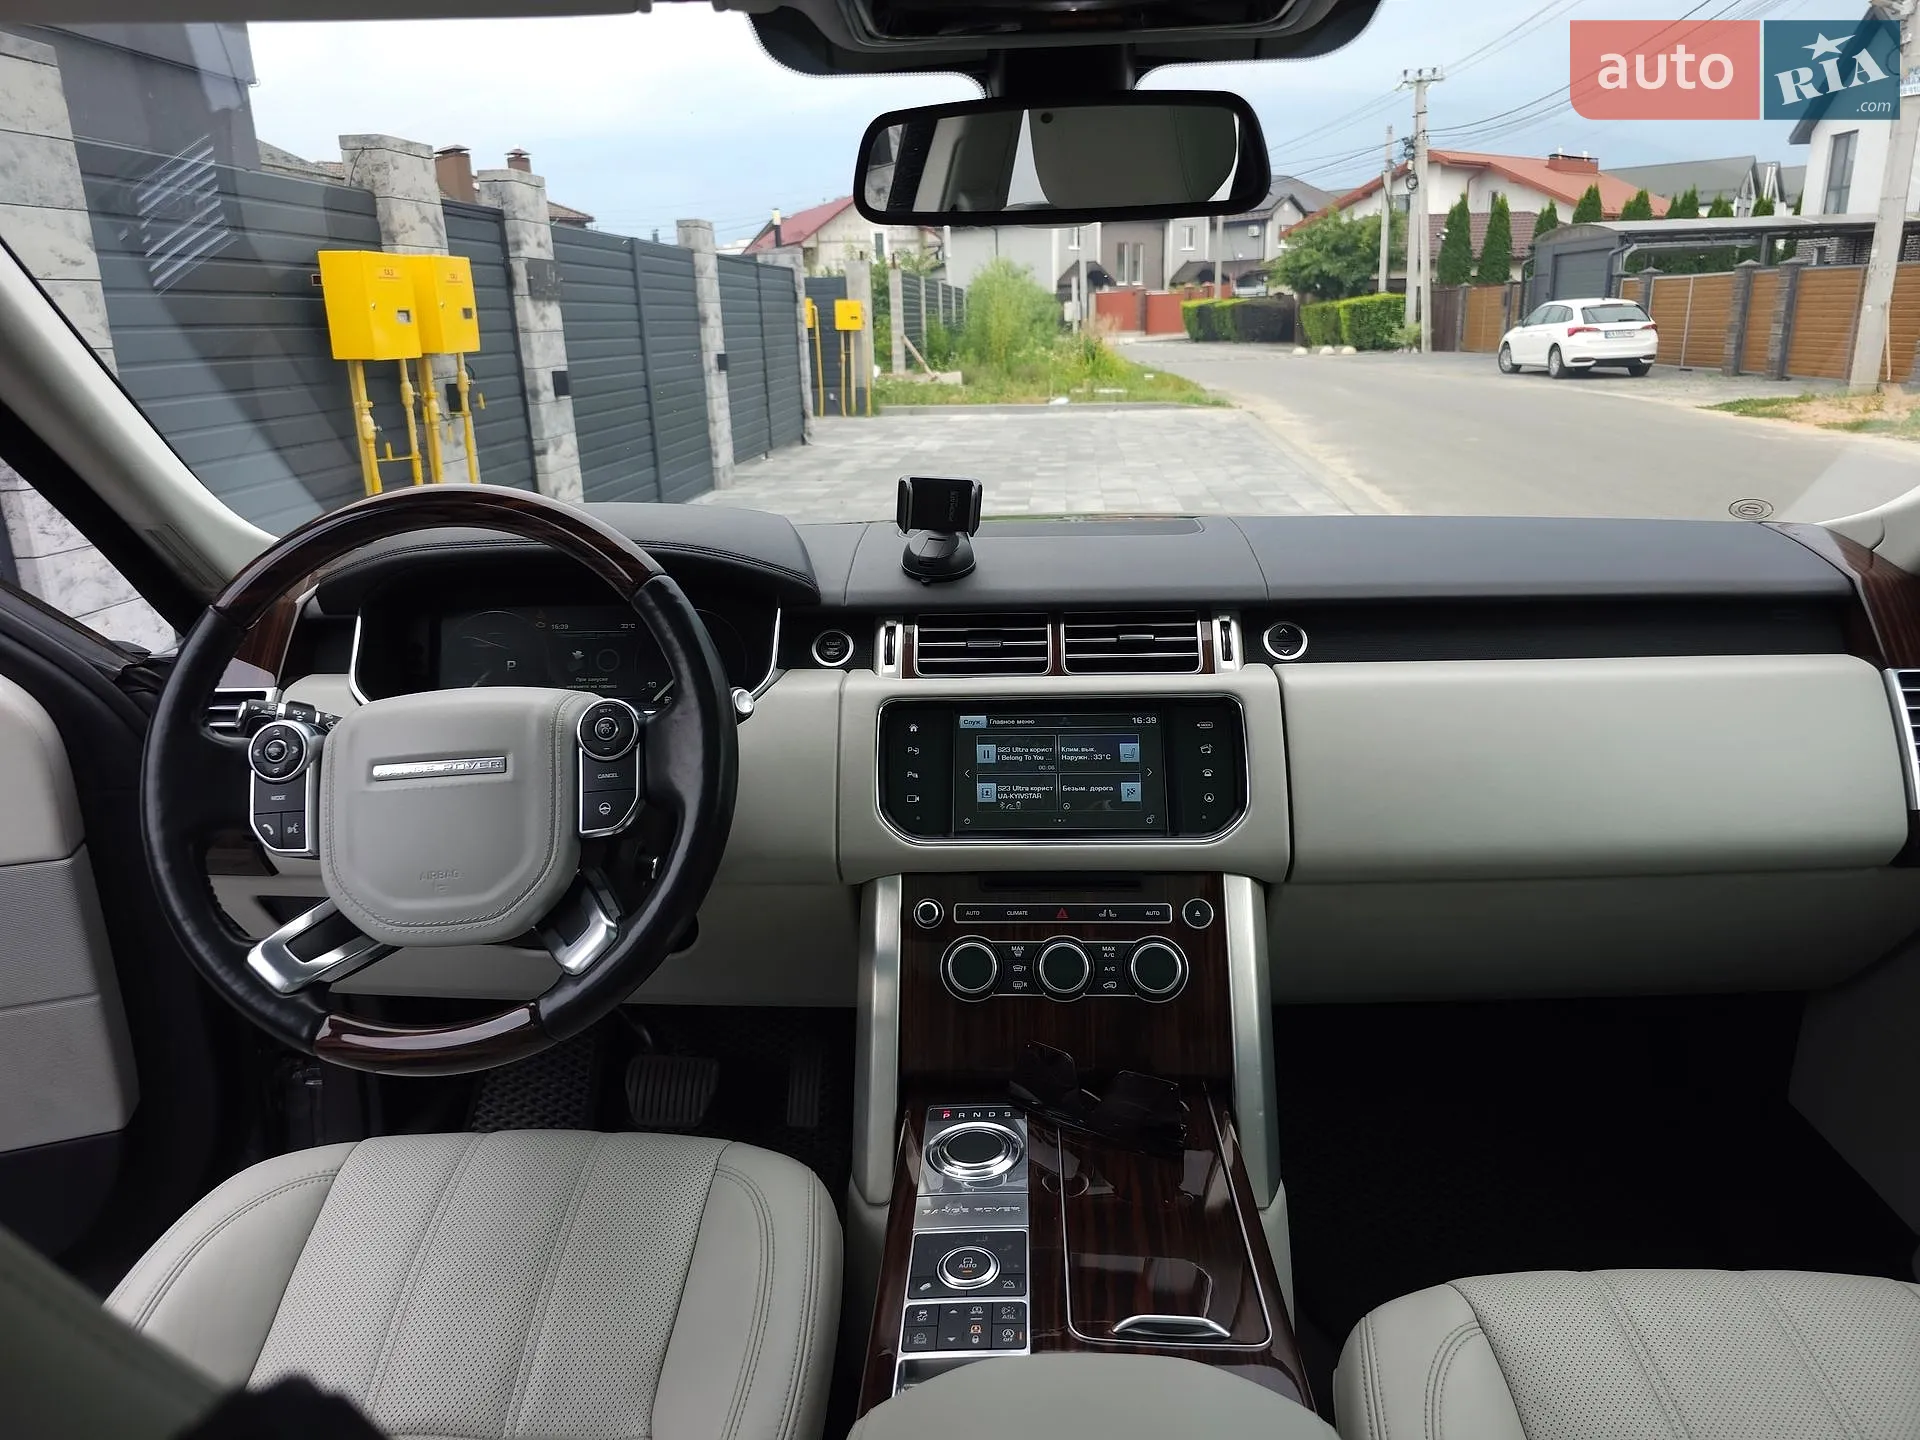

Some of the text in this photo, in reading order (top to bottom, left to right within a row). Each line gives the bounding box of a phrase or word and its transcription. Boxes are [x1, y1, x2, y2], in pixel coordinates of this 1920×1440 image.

[506, 660, 517, 671] P
[1131, 716, 1157, 724] 16:39
[1001, 754, 1023, 762] Belong
[943, 1111, 950, 1119] P
